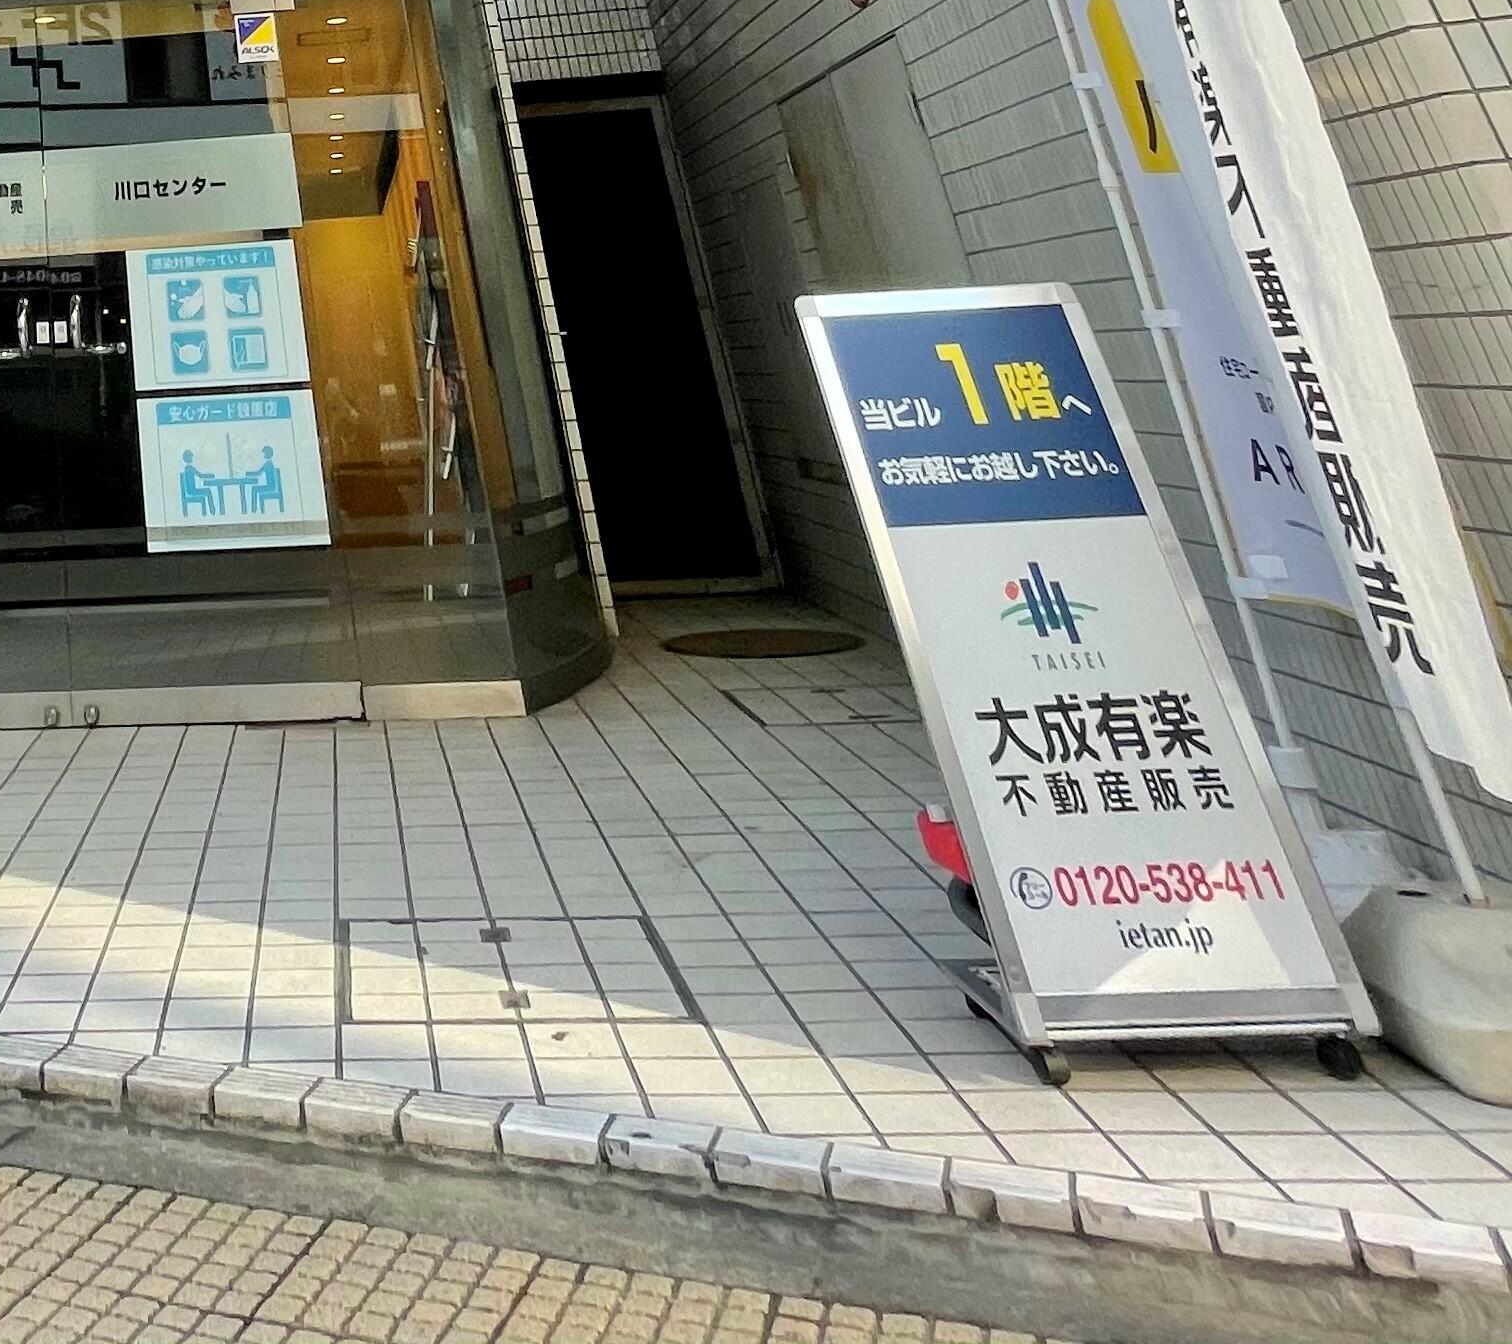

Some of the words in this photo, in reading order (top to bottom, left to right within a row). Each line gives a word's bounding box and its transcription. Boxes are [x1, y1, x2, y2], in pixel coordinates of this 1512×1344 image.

[241, 45, 275, 55] ALSOK
[114, 176, 227, 200] 川口センター
[877, 449, 1120, 486] お気軽にお越し下さい。
[1031, 650, 1107, 671] TAISEI
[974, 689, 1213, 766] 大成有楽
[995, 764, 1235, 817] 不動産販売
[1054, 858, 1285, 907] 0120-538-411
[1116, 918, 1214, 955] ietan.jp
